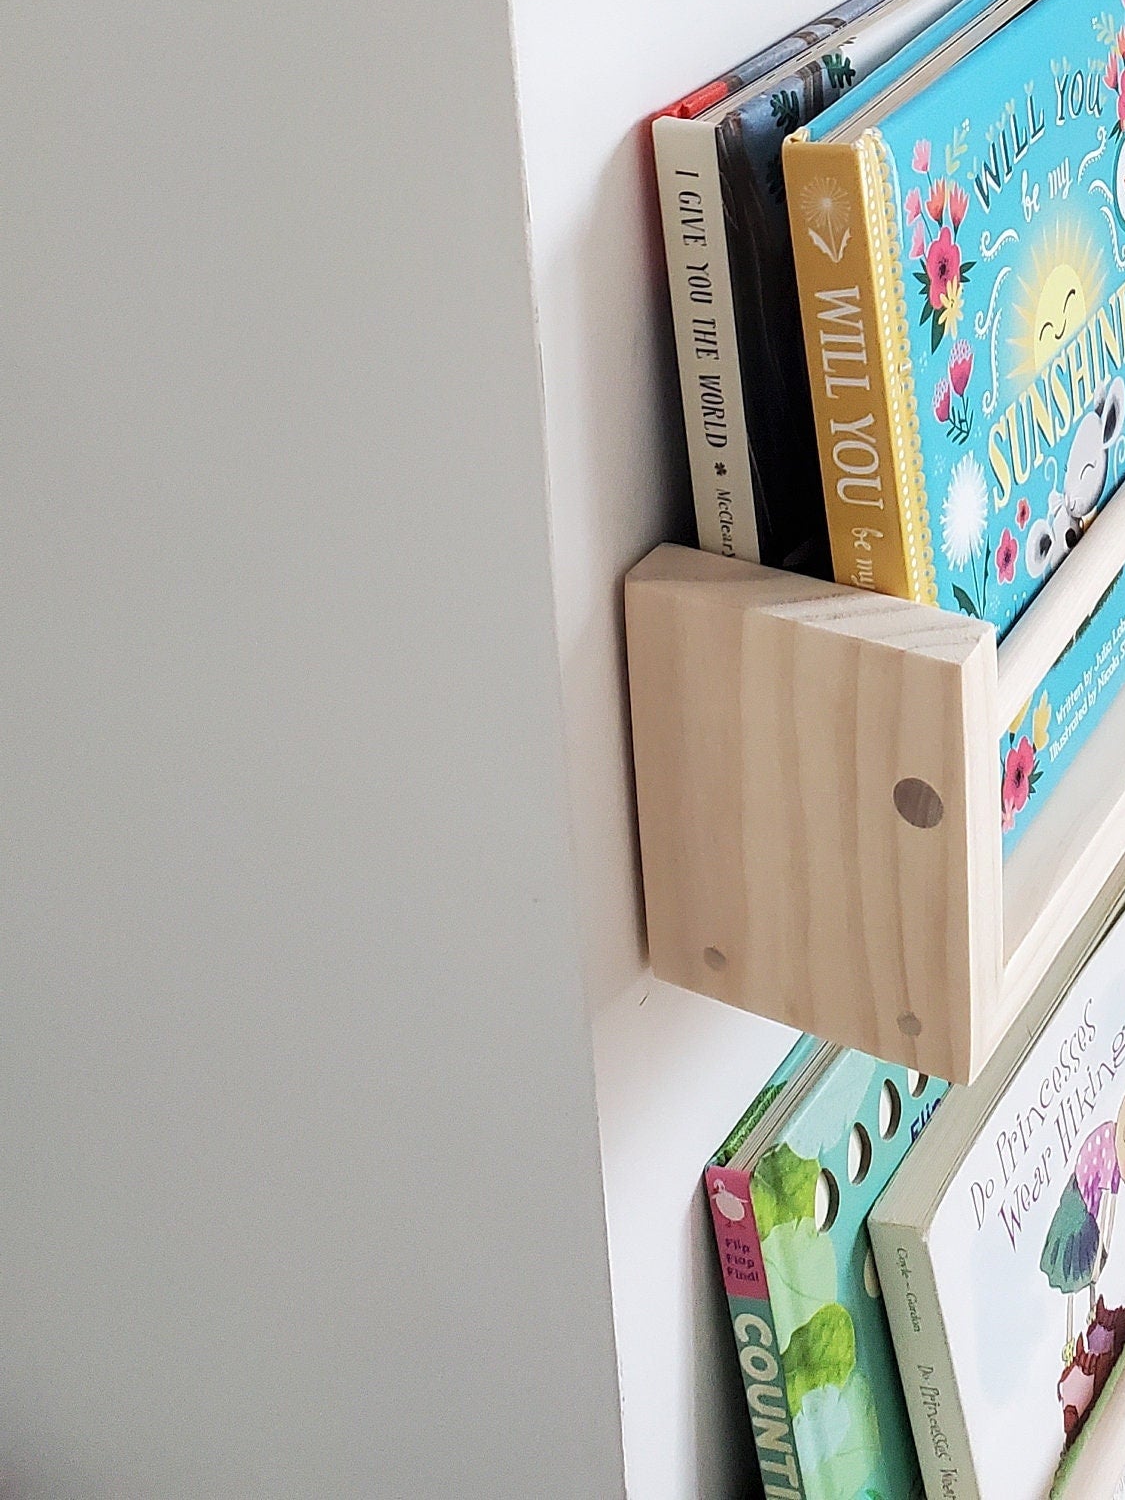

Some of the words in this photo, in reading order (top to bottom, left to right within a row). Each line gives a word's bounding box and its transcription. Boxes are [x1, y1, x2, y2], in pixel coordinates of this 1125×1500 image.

[675, 169, 699, 178] I
[973, 93, 1045, 214] WILL
[1053, 69, 1103, 126] YOU
[678, 190, 707, 248] GIVE
[1021, 169, 1040, 223] be
[1049, 157, 1074, 200] my
[685, 262, 713, 305] YOU
[692, 316, 720, 361] THE
[814, 285, 870, 399] WILL
[698, 373, 728, 449] WORLD
[829, 413, 885, 512] YOU
[851, 526, 884, 551] be
[1049, 703, 1089, 763] Illustrated
[1087, 686, 1097, 707] by
[1097, 656, 1120, 694] Nicola
[1055, 681, 1084, 725] Written
[1082, 665, 1093, 687] by
[1094, 638, 1113, 672] Julia
[970, 1177, 995, 1231] Do
[996, 997, 1098, 1186] Princesses
[997, 1146, 1051, 1253] Wear
